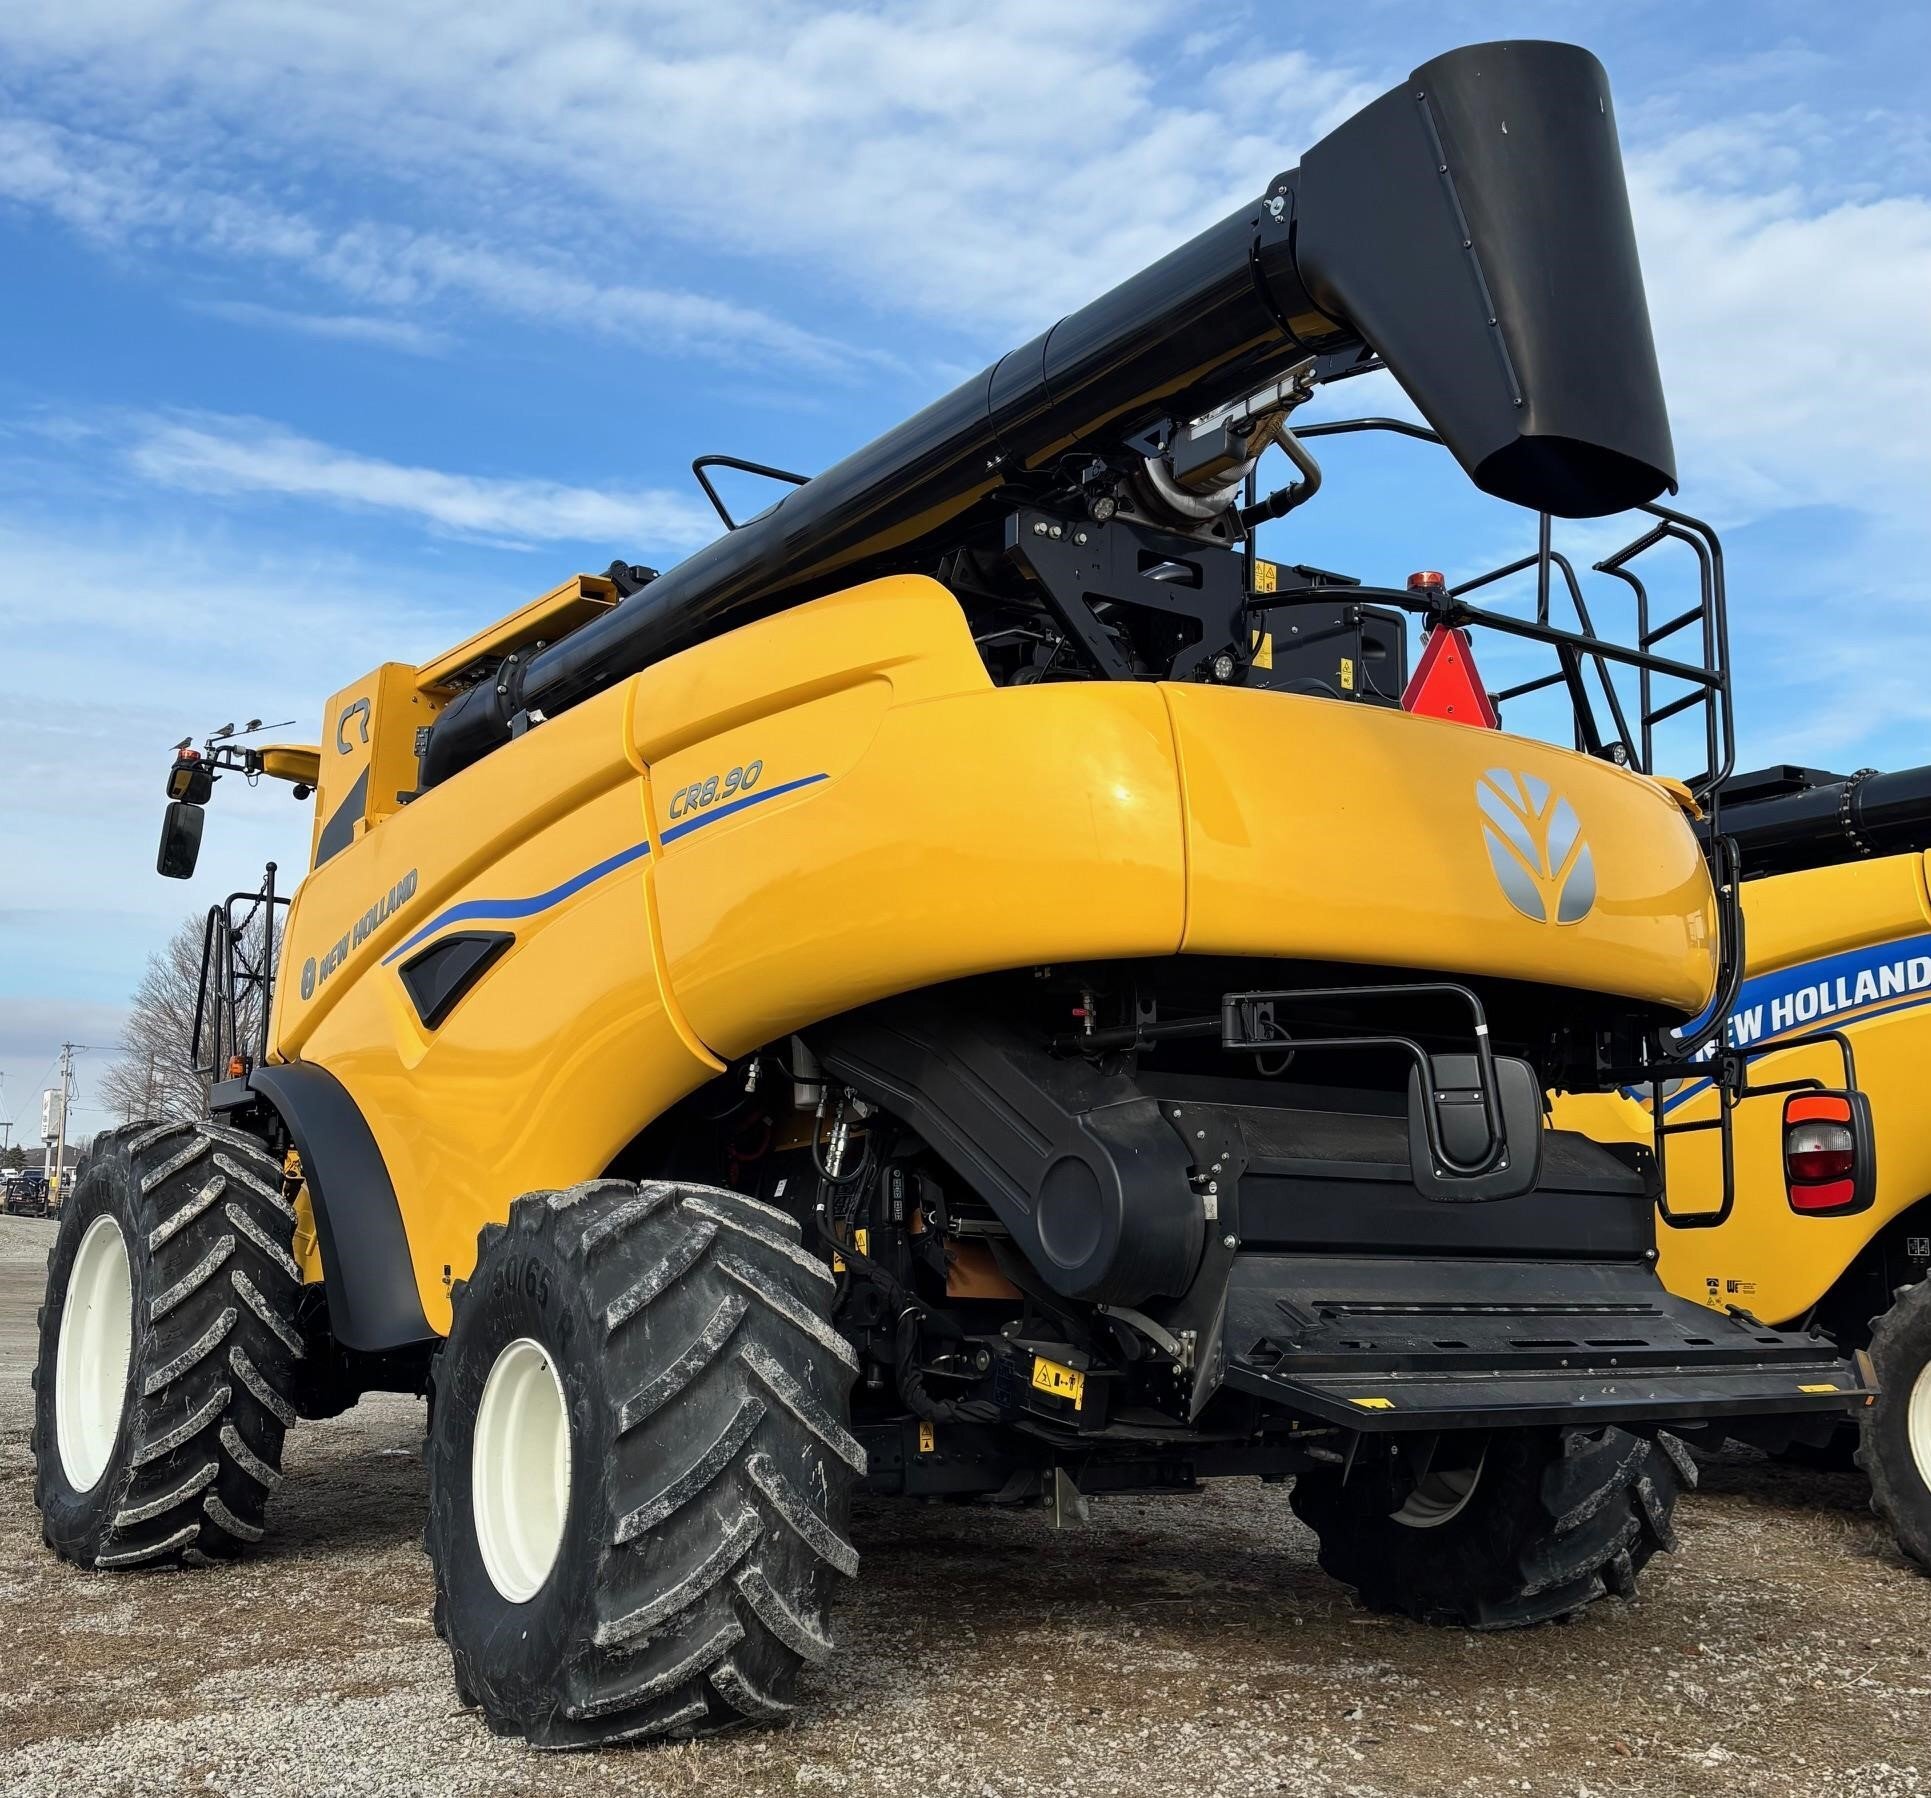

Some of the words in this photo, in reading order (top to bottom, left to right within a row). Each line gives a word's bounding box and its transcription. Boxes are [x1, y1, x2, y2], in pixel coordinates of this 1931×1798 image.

[669, 760, 763, 819] CR8.90
[318, 930, 351, 986] NEW
[352, 868, 418, 950] HOLLAND
[1771, 956, 1931, 1032] HOLLAND
